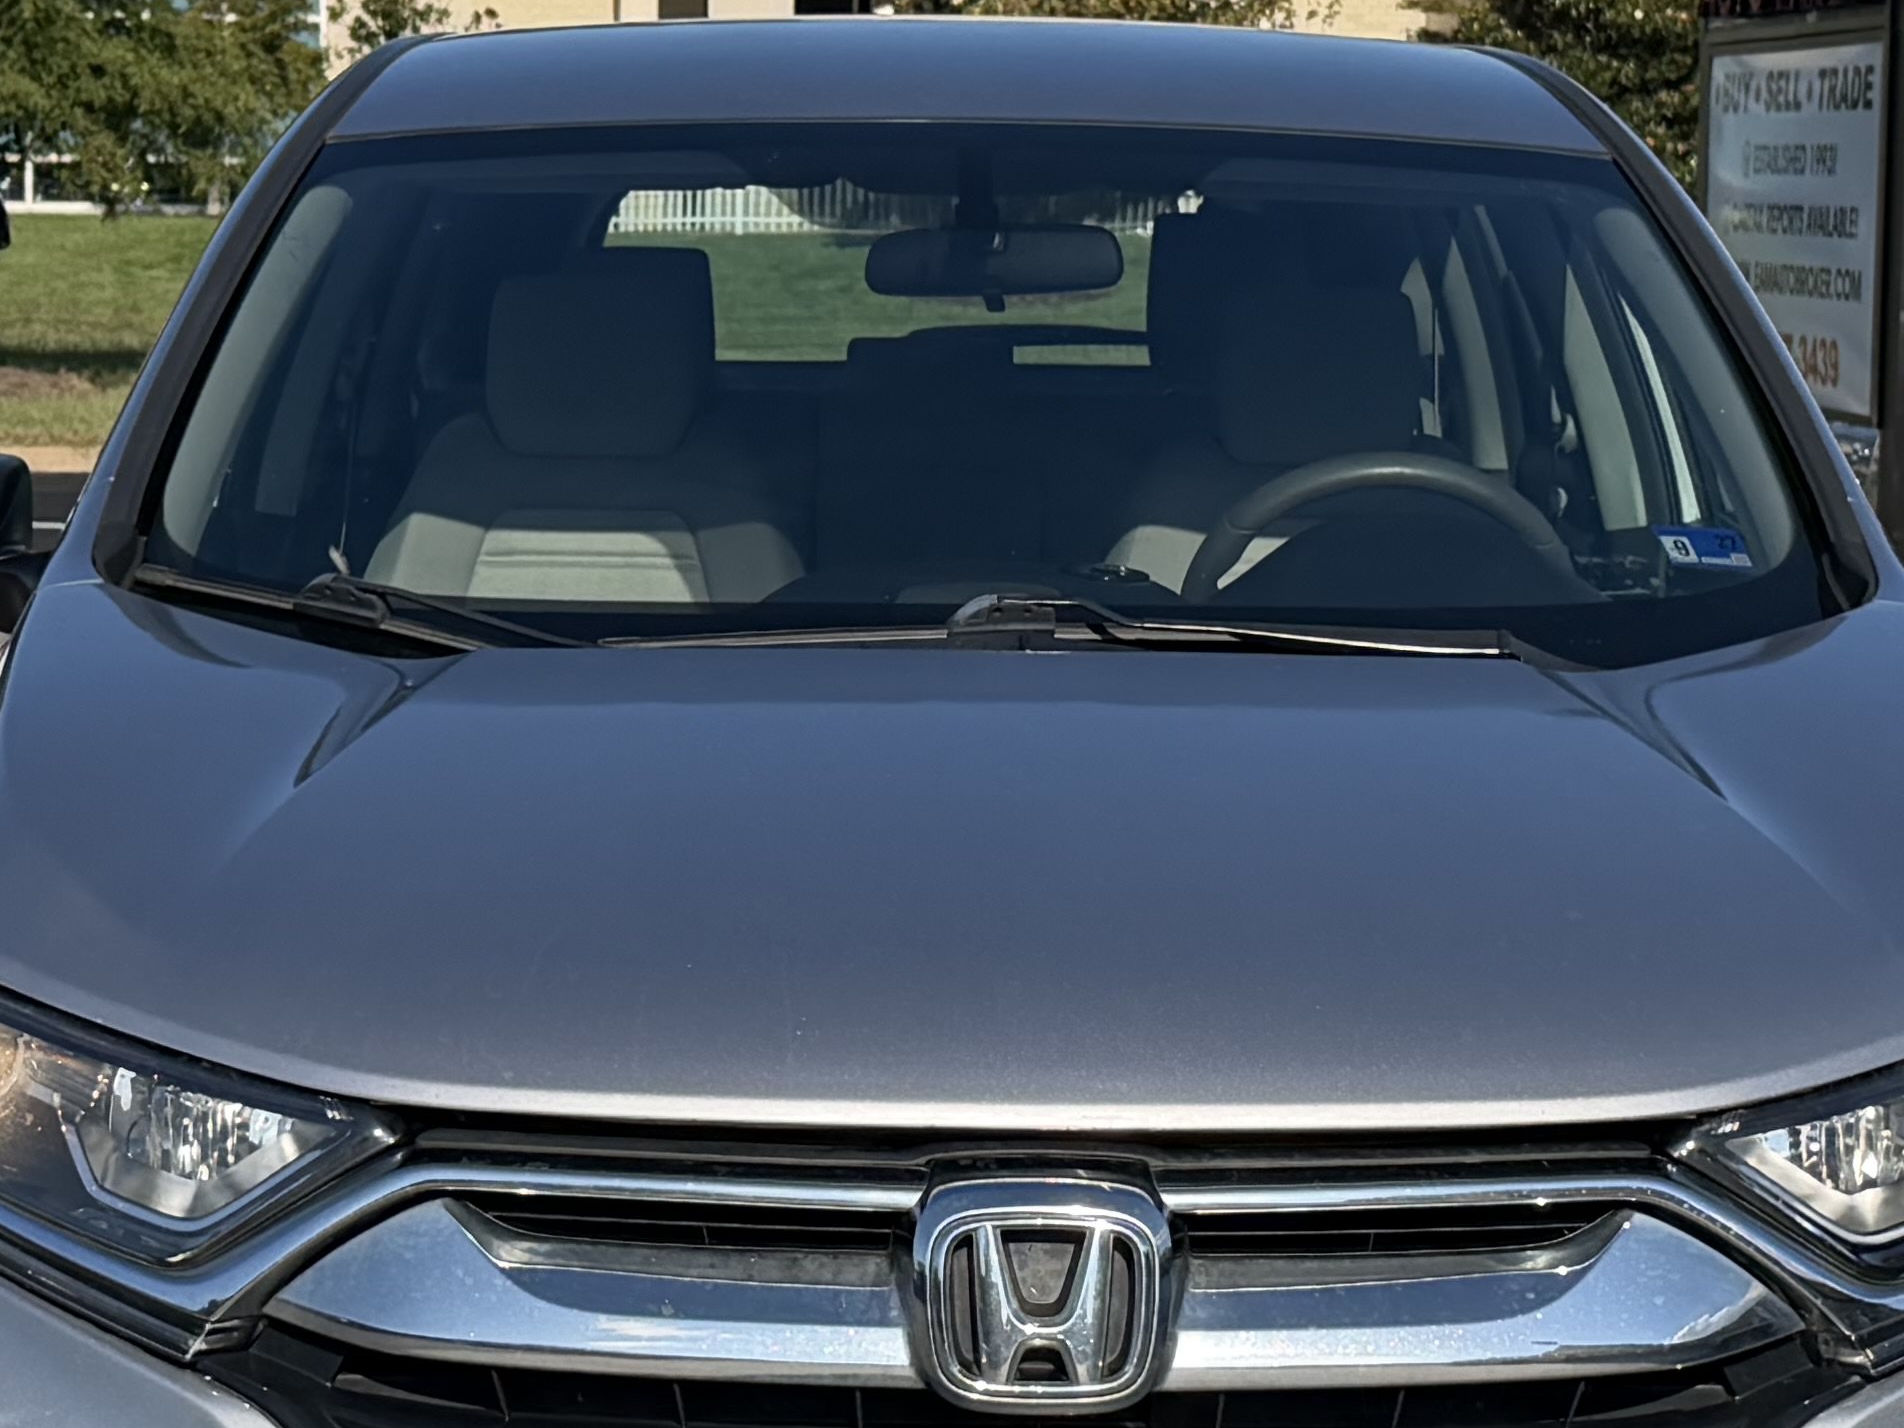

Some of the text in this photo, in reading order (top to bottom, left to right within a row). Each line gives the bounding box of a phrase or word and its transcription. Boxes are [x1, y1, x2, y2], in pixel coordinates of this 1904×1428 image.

[1722, 64, 1875, 113] BUY SELL TRADE
[1672, 539, 1690, 557] 9
